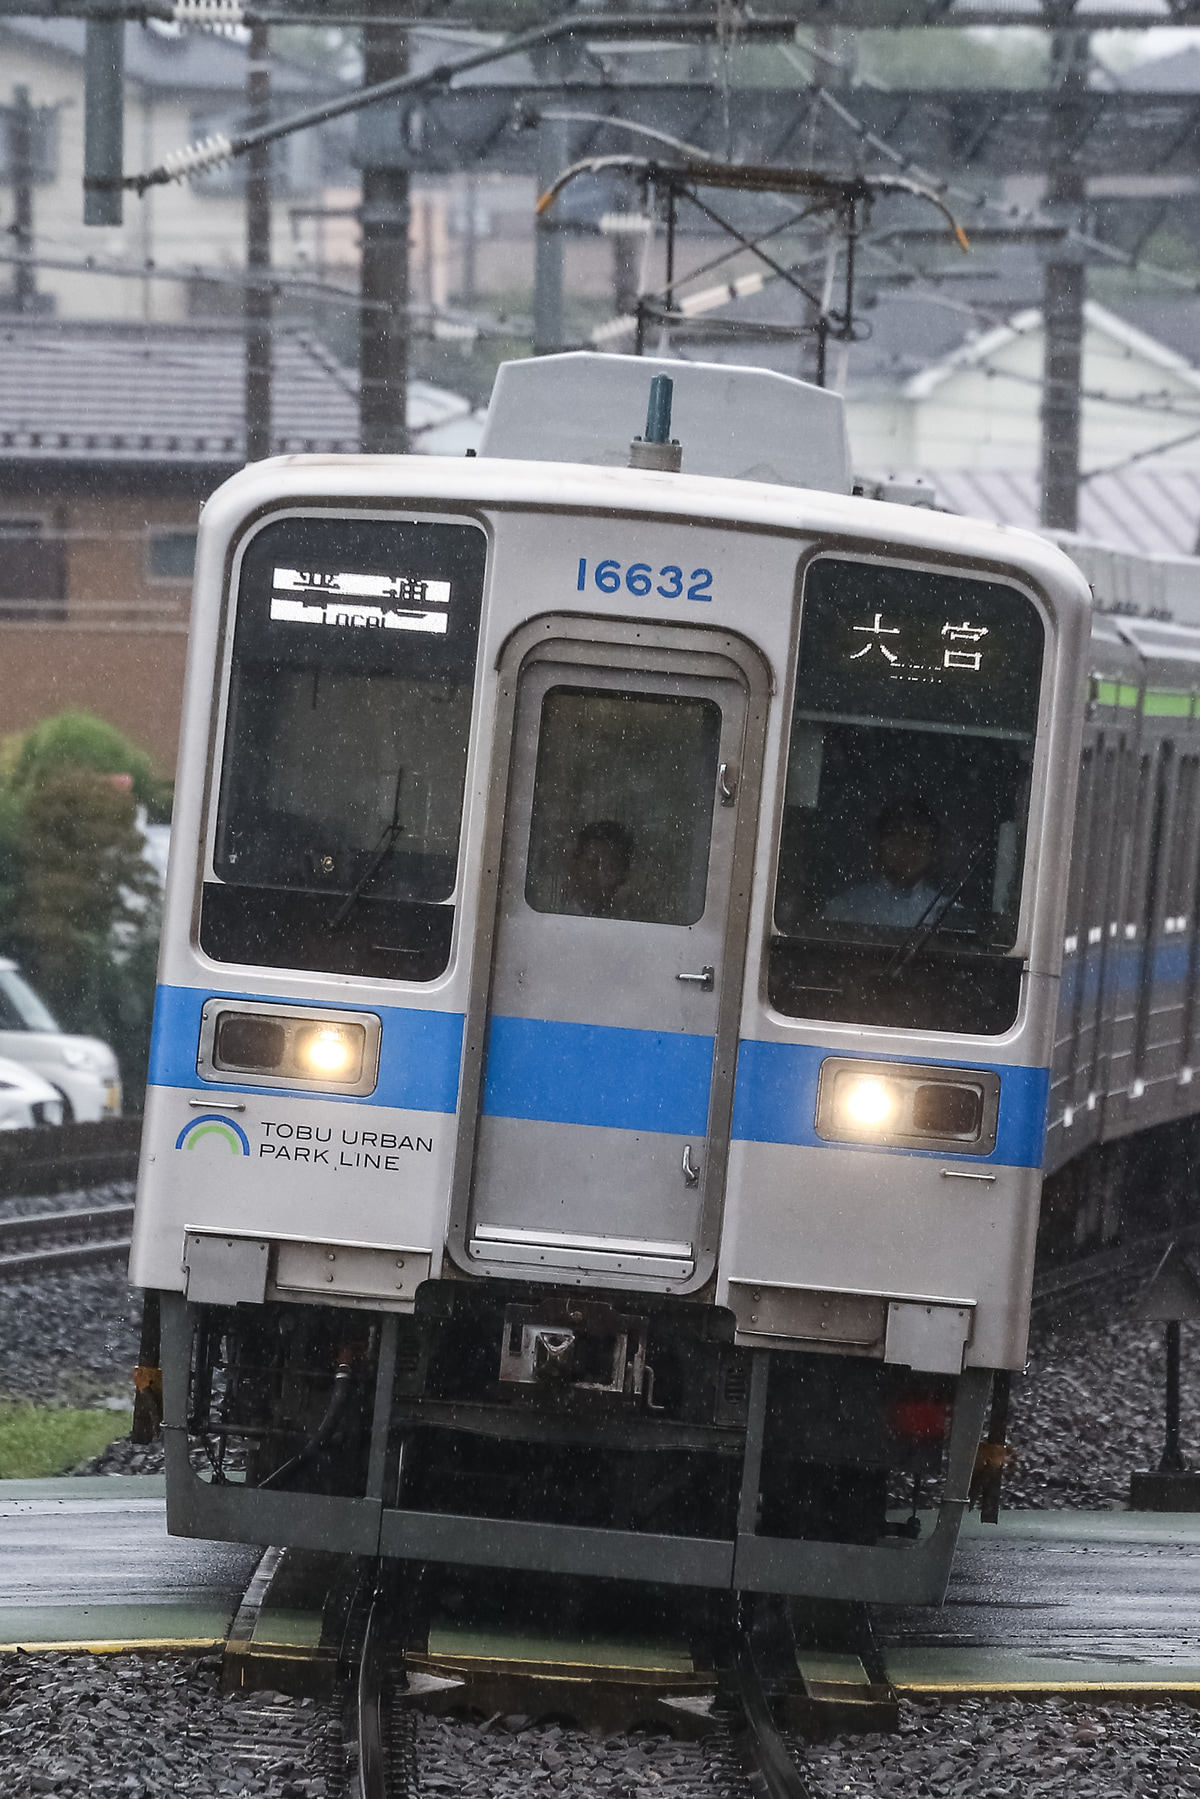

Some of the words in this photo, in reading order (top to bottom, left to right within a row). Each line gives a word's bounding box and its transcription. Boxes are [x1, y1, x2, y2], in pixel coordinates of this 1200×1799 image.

[577, 557, 713, 602] 16632
[850, 613, 989, 671] 大宮
[261, 1121, 331, 1143] TOBU
[342, 1129, 433, 1152] URBAN
[259, 1143, 329, 1164] PARK
[339, 1151, 400, 1171] LINE
